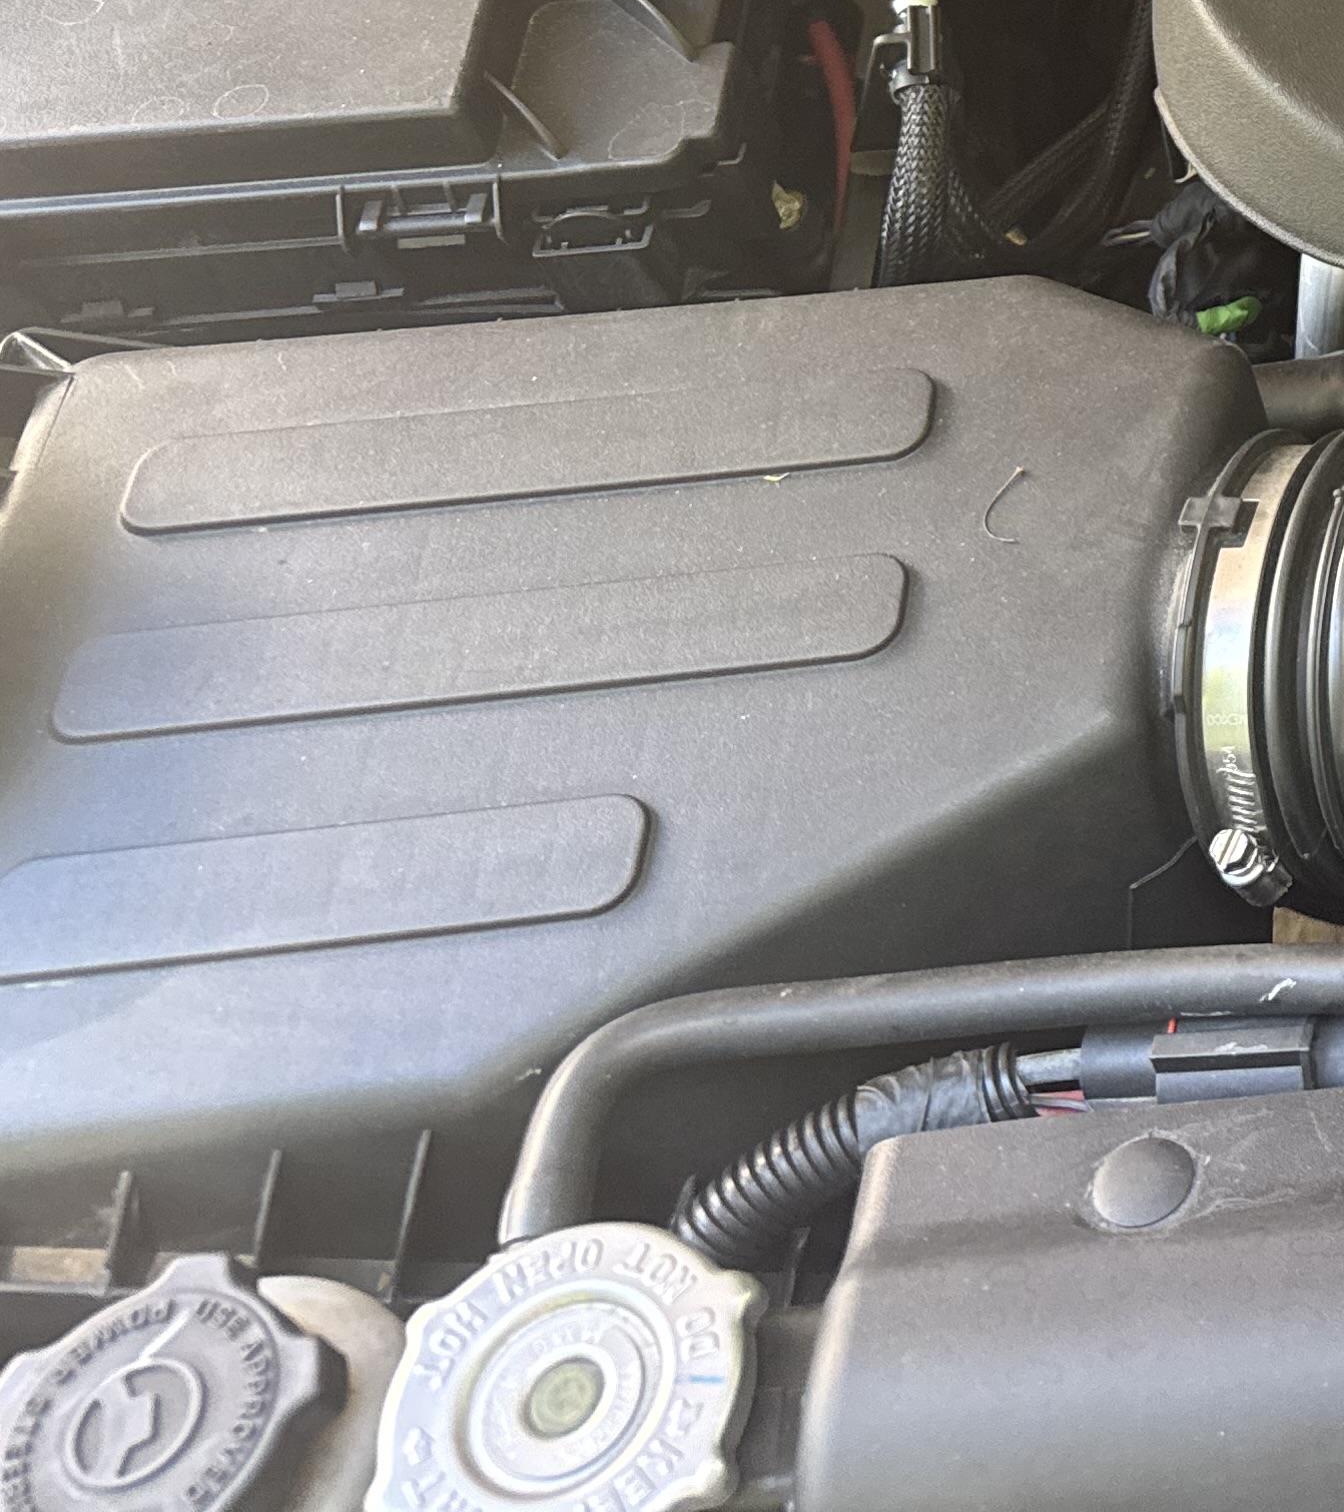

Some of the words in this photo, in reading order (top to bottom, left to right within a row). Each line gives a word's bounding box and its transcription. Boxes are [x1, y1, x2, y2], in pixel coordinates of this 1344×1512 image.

[492, 1236, 606, 1304] OPEN
[613, 1241, 700, 1306] NOT
[195, 1296, 253, 1342] USE
[413, 1301, 490, 1391] HOT
[677, 1306, 722, 1365] DO
